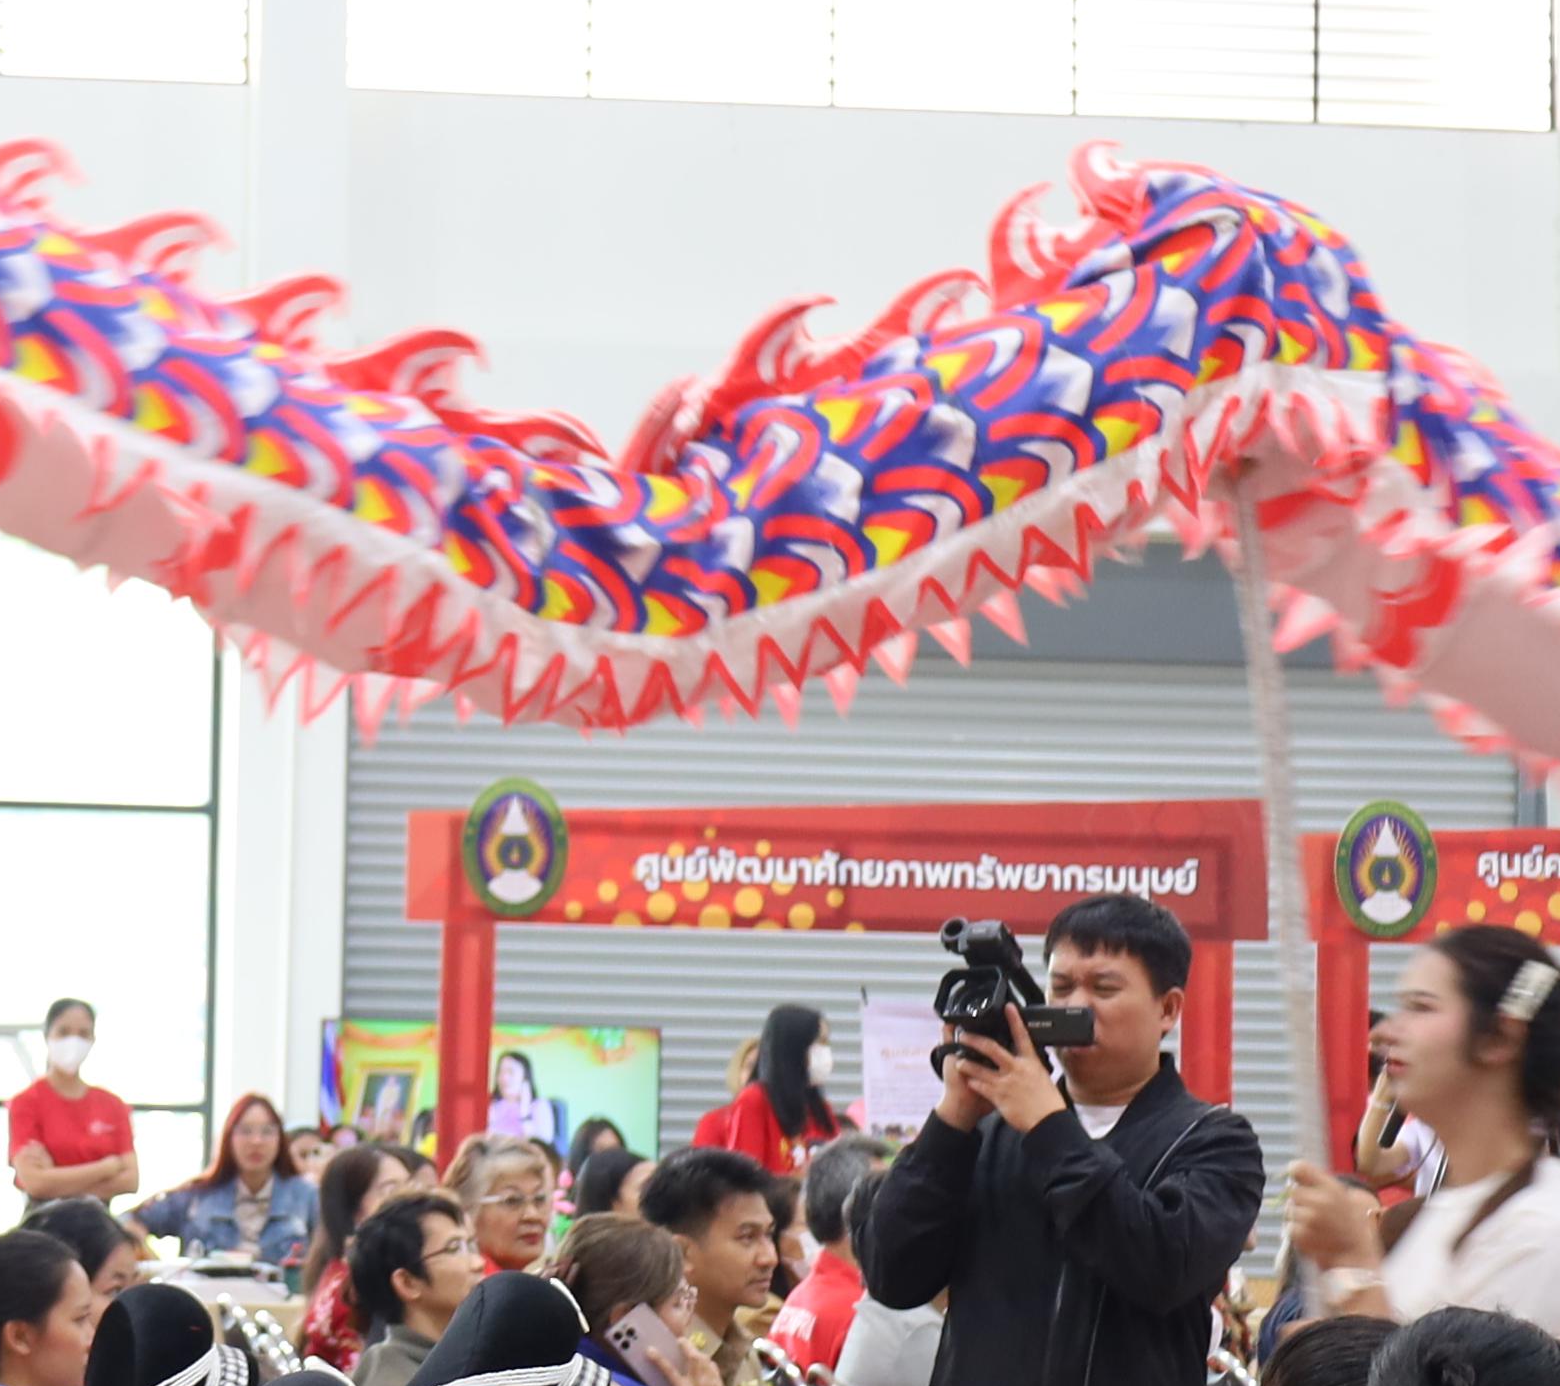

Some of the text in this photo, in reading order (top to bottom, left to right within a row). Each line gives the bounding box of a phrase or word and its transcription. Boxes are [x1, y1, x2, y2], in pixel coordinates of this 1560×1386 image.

[635, 847, 1199, 897] ศูนย์พัฒนาศักยภาพทรัพยากรมนุษย์
